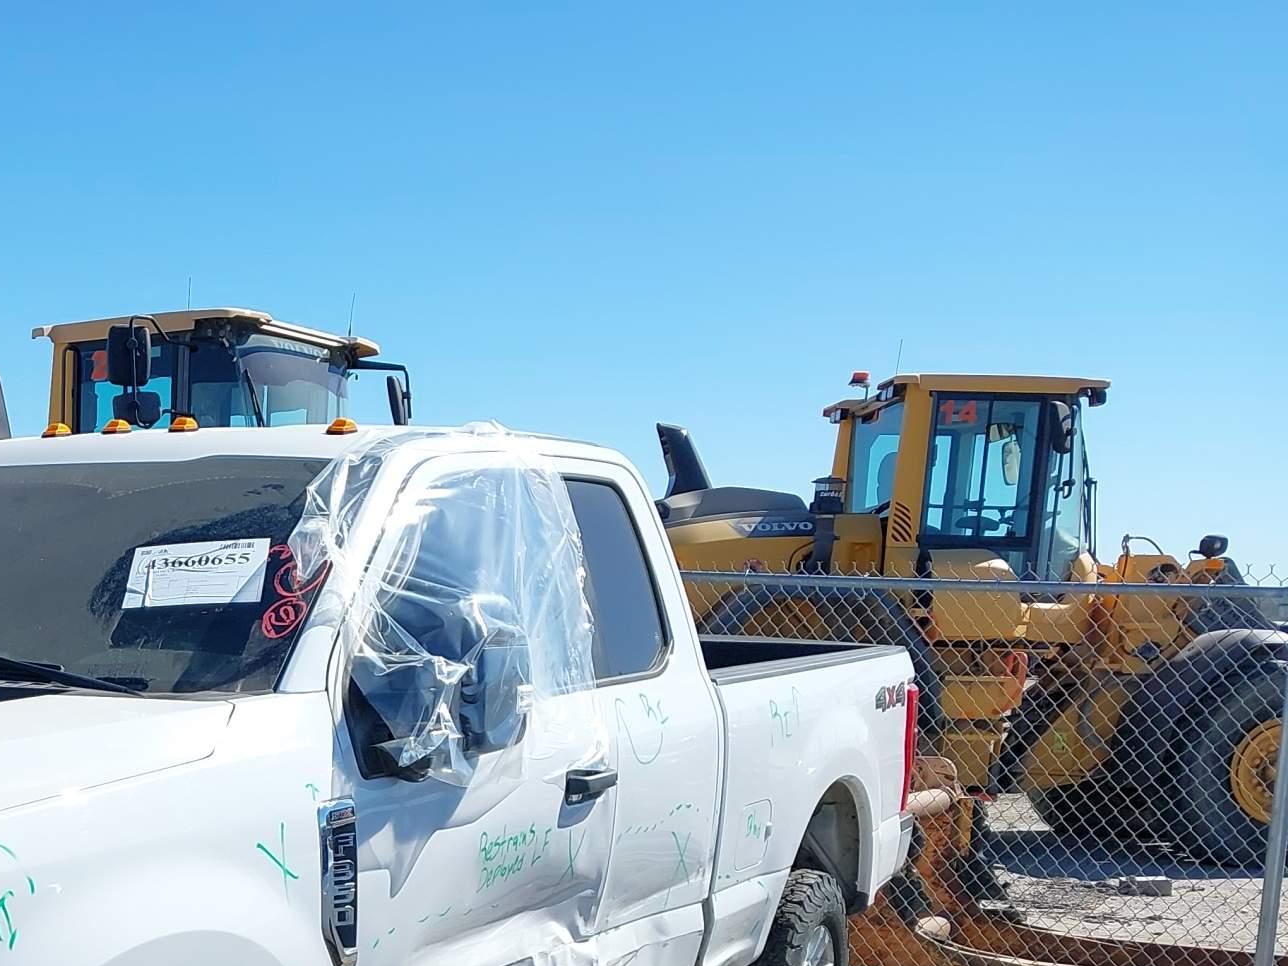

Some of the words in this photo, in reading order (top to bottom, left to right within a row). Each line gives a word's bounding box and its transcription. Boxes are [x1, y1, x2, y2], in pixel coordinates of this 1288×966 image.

[939, 399, 978, 426] 14
[739, 521, 814, 532] VOLVO
[144, 551, 252, 570] 43660655
